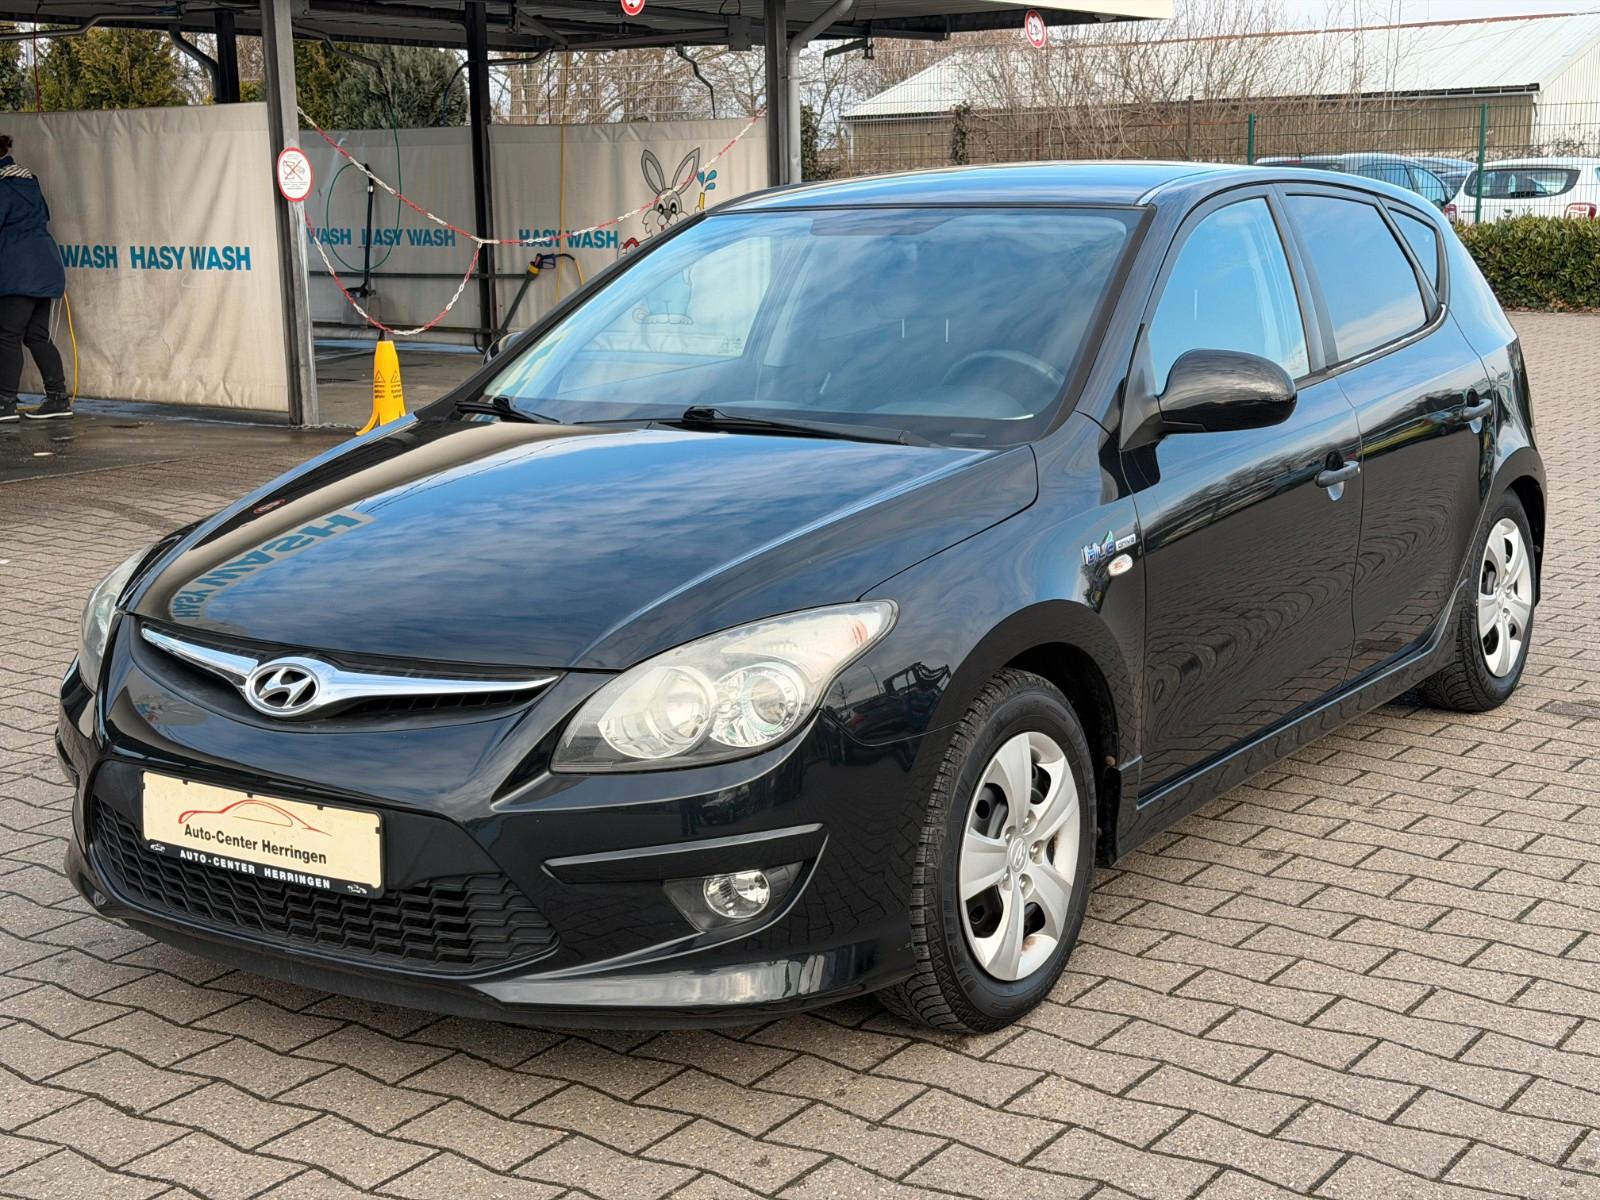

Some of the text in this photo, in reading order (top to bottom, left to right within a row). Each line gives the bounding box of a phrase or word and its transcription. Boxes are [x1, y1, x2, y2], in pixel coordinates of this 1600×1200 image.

[406, 228, 456, 247] WASH
[565, 229, 618, 248] WASH
[59, 244, 251, 271] WASH HASY WASH
[184, 823, 327, 864] Auto-Center Herringen
[179, 849, 331, 889] AUTO-CENTER HERRINGEN
